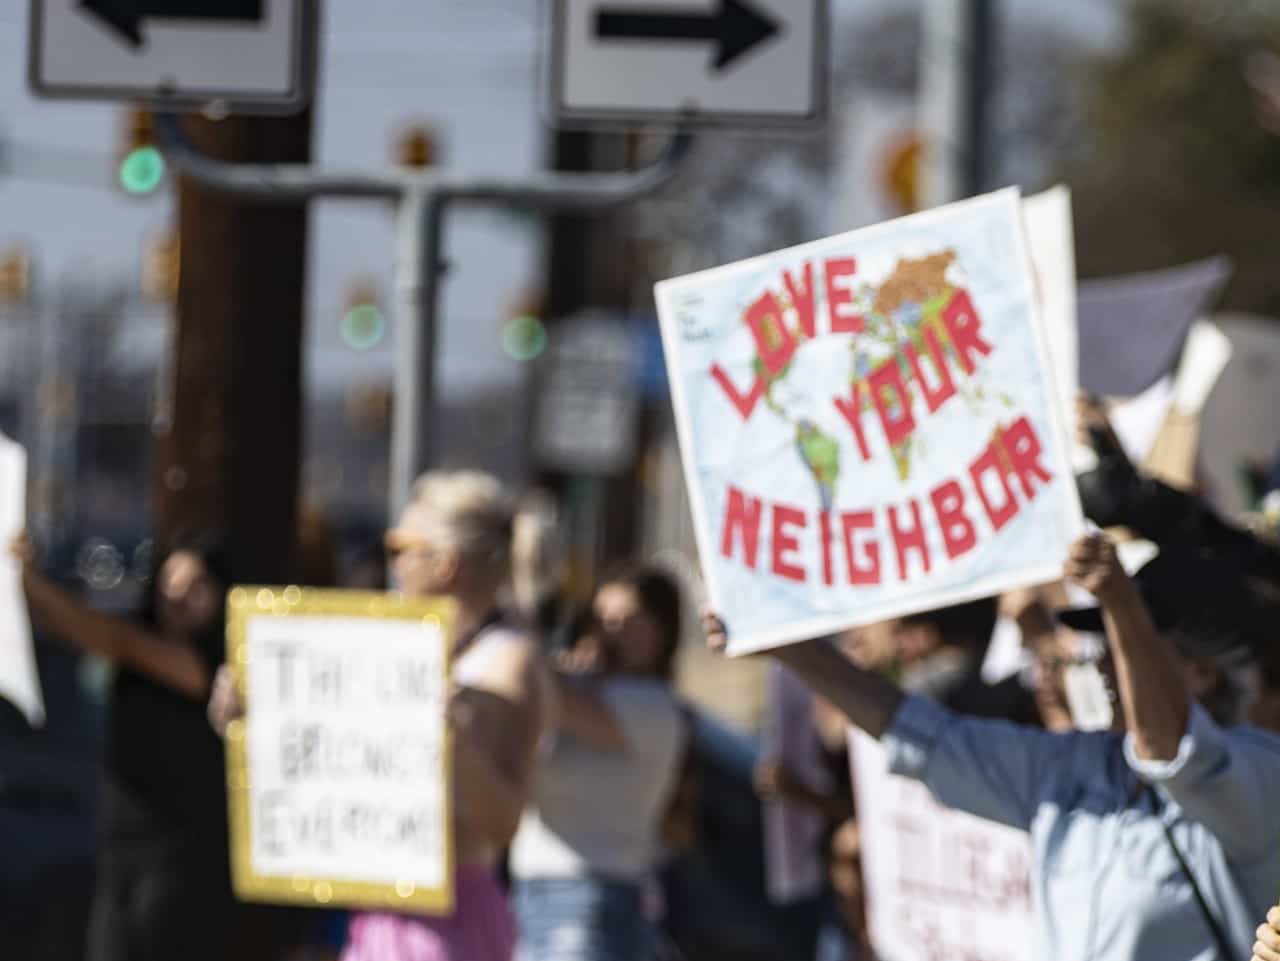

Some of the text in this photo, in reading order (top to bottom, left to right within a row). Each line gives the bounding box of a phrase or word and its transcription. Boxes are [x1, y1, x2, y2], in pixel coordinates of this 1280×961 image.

[709, 257, 864, 420] LOVE
[833, 288, 992, 462] YOUR
[720, 416, 1052, 588] NEIGHBOR
